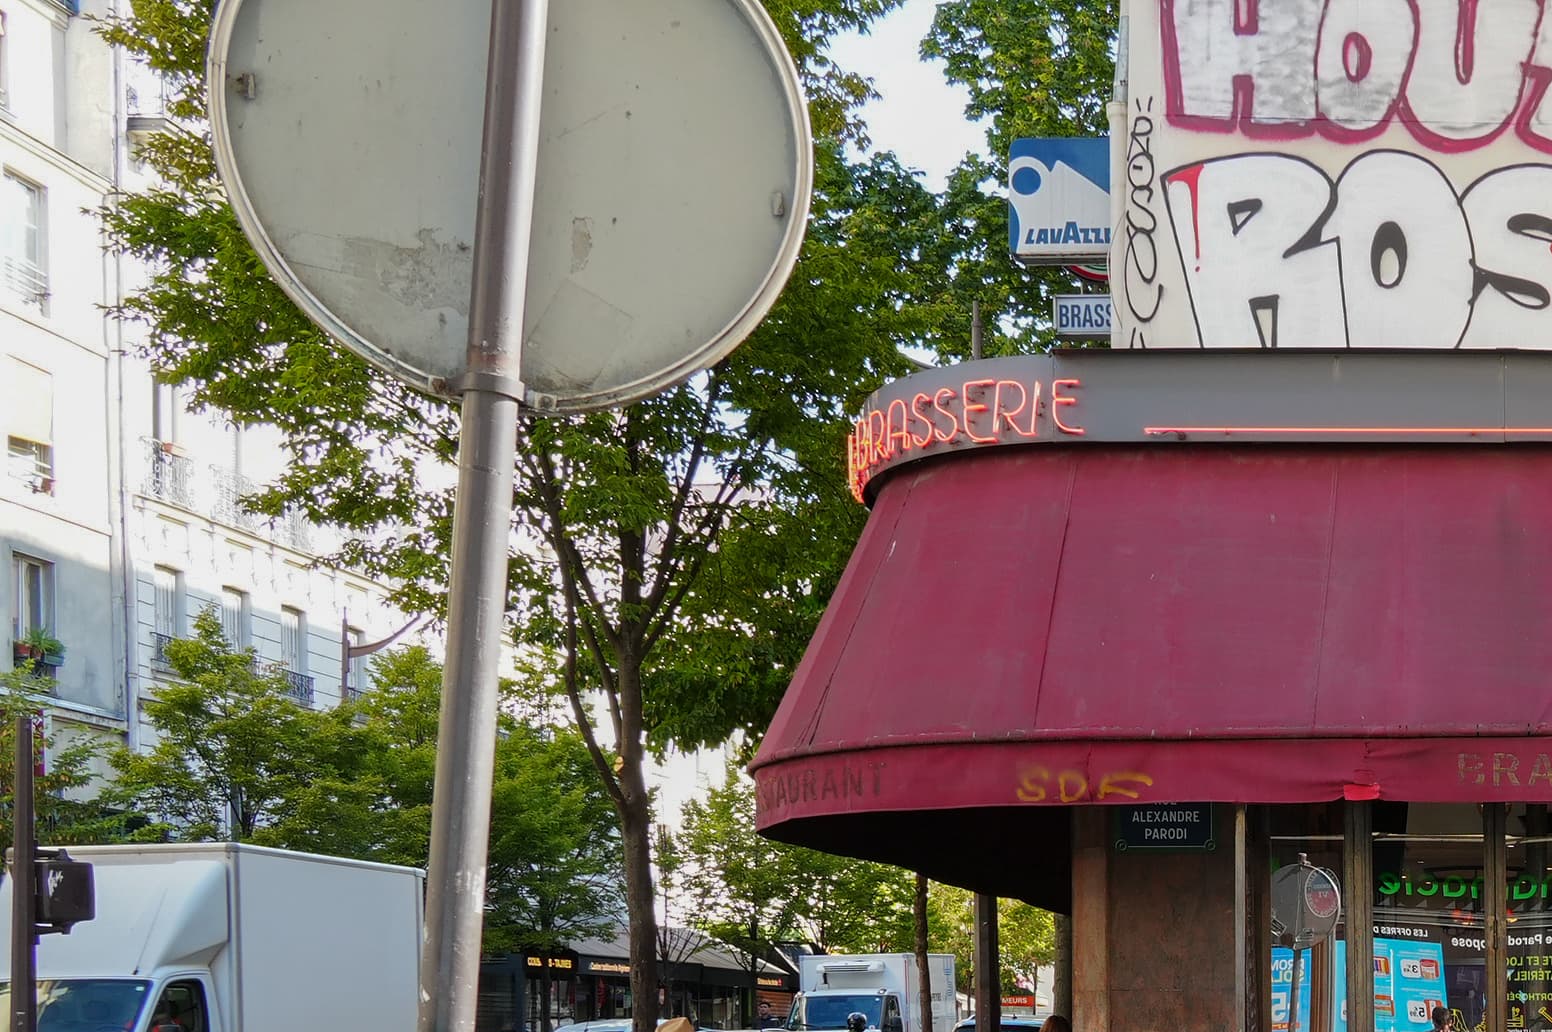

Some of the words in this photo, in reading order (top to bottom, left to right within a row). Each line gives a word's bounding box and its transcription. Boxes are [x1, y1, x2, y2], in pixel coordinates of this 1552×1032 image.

[855, 378, 1086, 471] BRASSERIE
[1132, 810, 1200, 824] ALEXANDRE
[1144, 827, 1188, 841] PARODI
